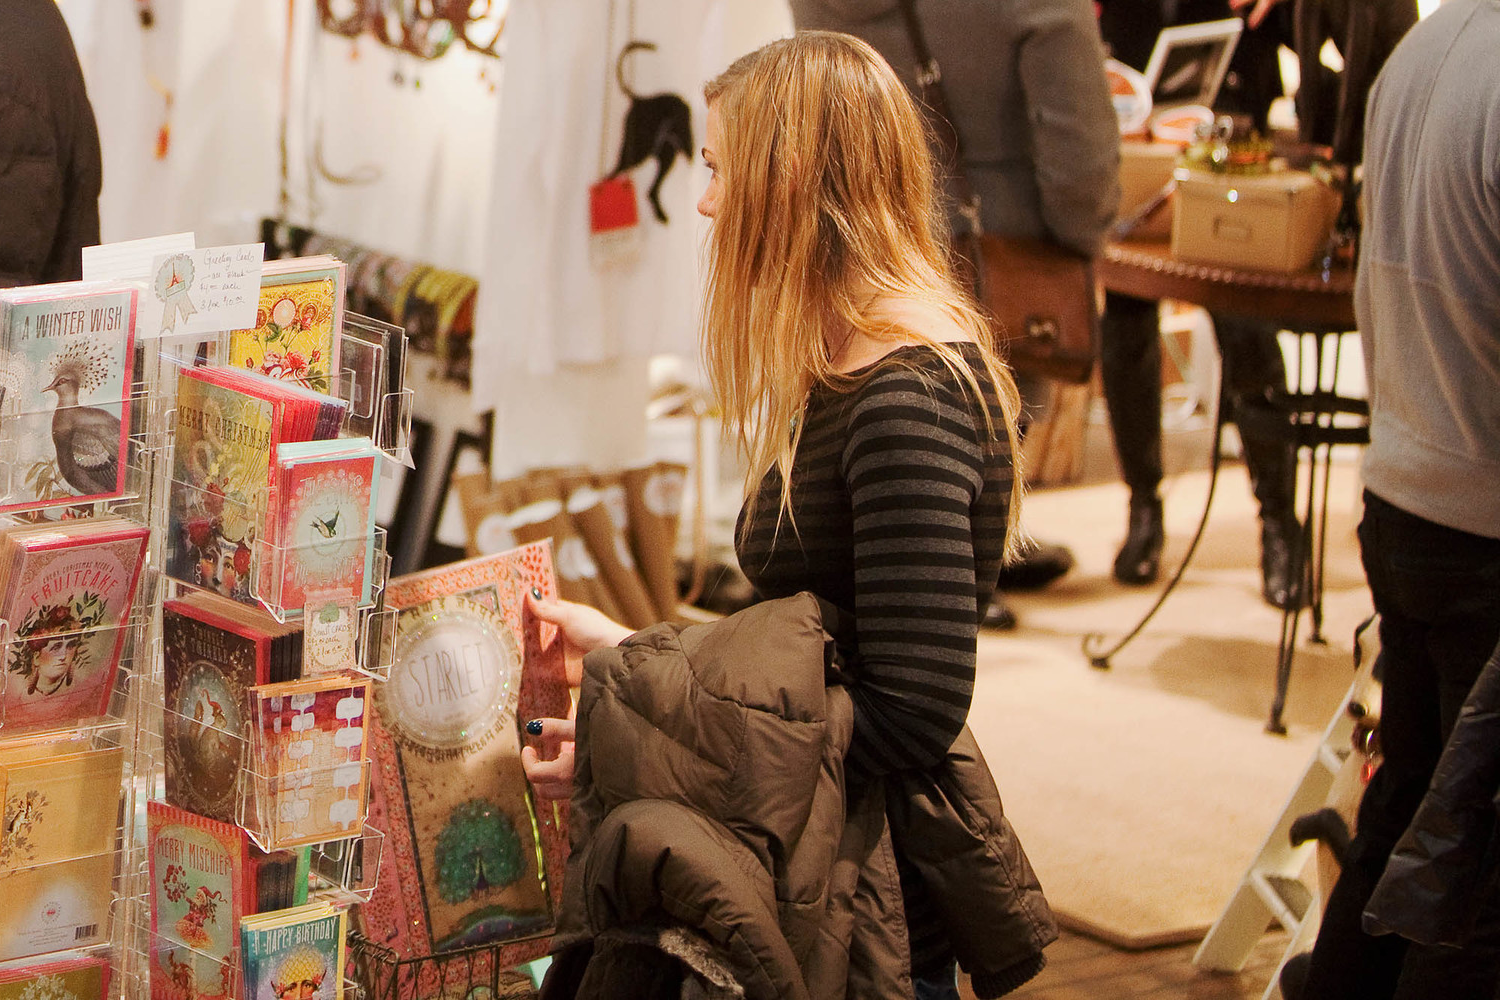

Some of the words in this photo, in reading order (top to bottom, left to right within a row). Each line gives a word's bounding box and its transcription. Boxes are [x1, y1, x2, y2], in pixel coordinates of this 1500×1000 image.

[21, 316, 30, 341] A
[35, 309, 85, 340] WINTER
[90, 305, 123, 333] WISH
[215, 416, 270, 452] CHRISTMAS
[30, 569, 119, 608] FRUITCAKE
[407, 642, 487, 708] STARLET
[157, 836, 185, 864] MERRY
[188, 842, 229, 876] MISCHIEF
[266, 927, 294, 955] HAPPY
[296, 915, 338, 944] BIRTHDAY
